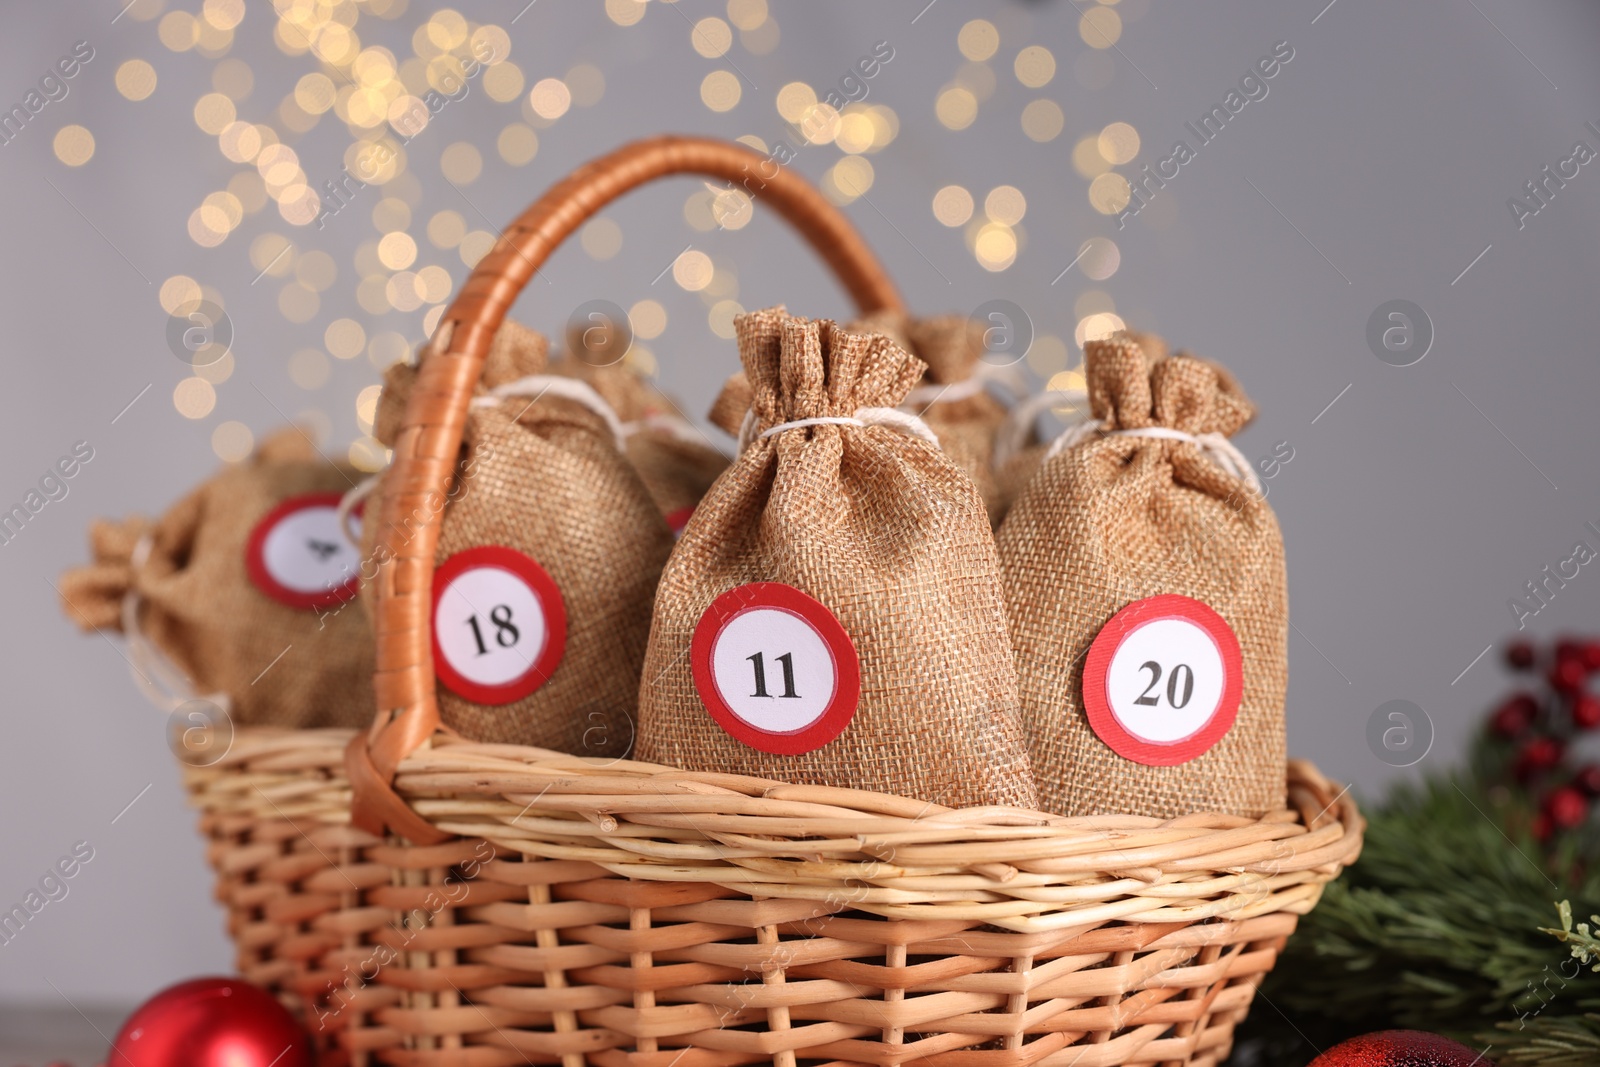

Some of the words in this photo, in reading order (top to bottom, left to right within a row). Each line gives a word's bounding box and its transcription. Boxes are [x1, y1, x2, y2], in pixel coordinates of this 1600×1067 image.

[467, 605, 520, 657] 18
[745, 651, 802, 699] 11
[1132, 660, 1194, 709] 20
